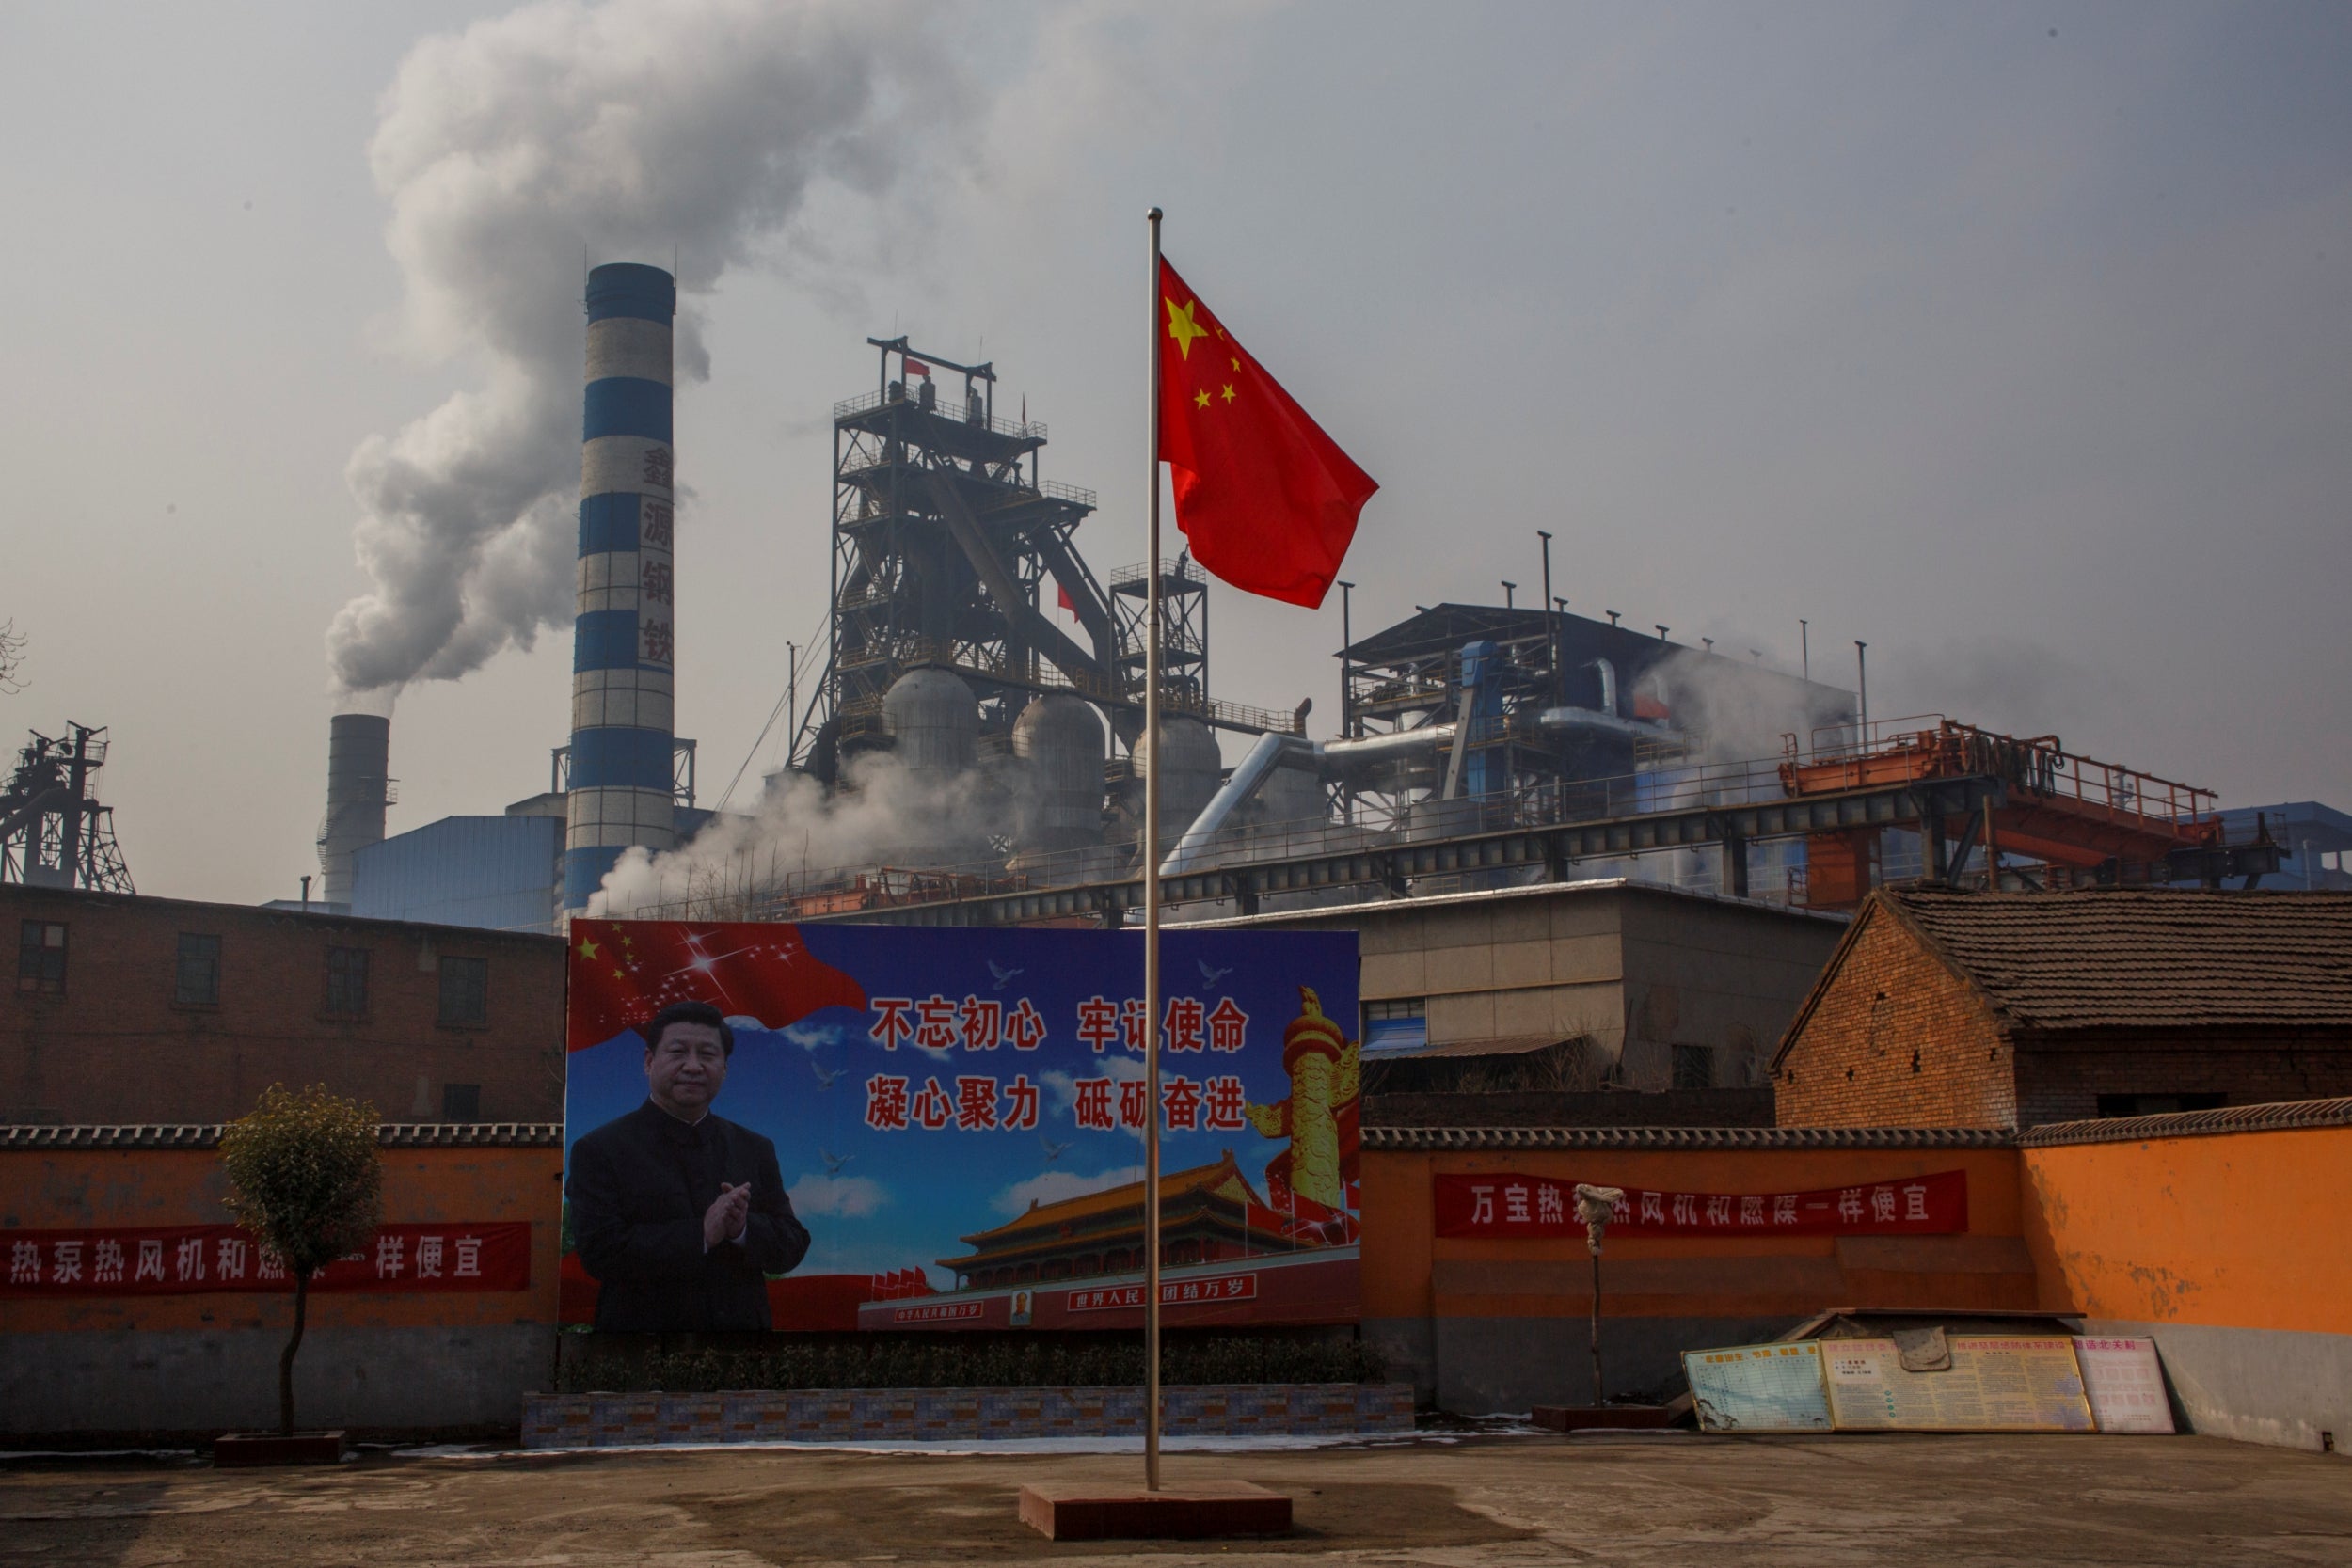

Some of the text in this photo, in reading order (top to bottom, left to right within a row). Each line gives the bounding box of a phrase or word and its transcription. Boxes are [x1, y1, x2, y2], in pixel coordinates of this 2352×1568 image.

[870, 995, 1248, 1052] 不忘初心 牢记使命
[866, 1075, 1247, 1129] 凝心聚力 砥砺奋进
[9, 1234, 483, 1285] 热泵热风机和燃一样便宜
[1076, 1279, 1244, 1307] 世界人民团结万岁
